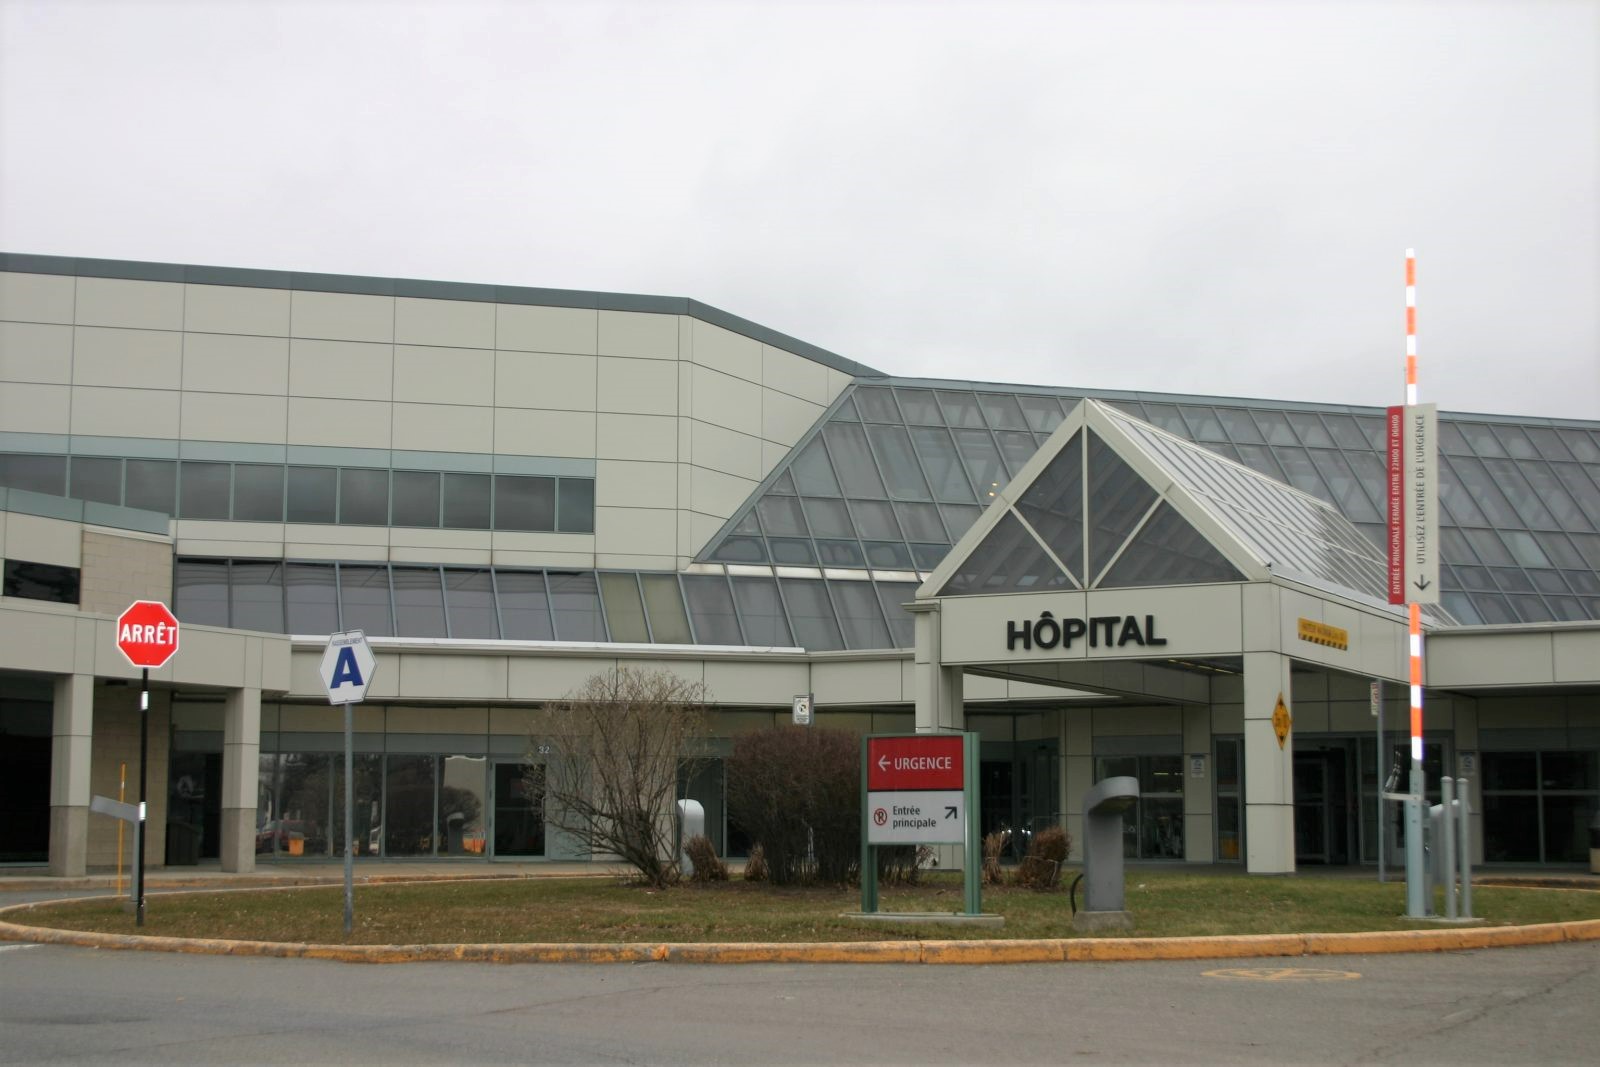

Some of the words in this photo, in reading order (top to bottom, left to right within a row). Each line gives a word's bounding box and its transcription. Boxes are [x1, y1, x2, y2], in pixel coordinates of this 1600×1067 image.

[1392, 439, 1400, 447] ET
[1415, 414, 1425, 463] L'URGENCE
[1392, 472, 1400, 495] ENTRE
[1415, 467, 1425, 478] DE
[1391, 497, 1400, 524] FERMÉE
[1413, 482, 1425, 522] L'ENTRÉE
[1392, 526, 1400, 566] PRINCIPALE
[1415, 525, 1425, 564] UTILISEZ
[1392, 568, 1400, 594] ENTRÉE
[120, 622, 176, 644] ARRÊT
[1007, 611, 1167, 650] HÔPITAL
[330, 646, 364, 689] A
[538, 745, 550, 754] 32
[894, 756, 952, 770] URGENCE
[892, 805, 920, 815] Entrée
[892, 818, 937, 829] principale
